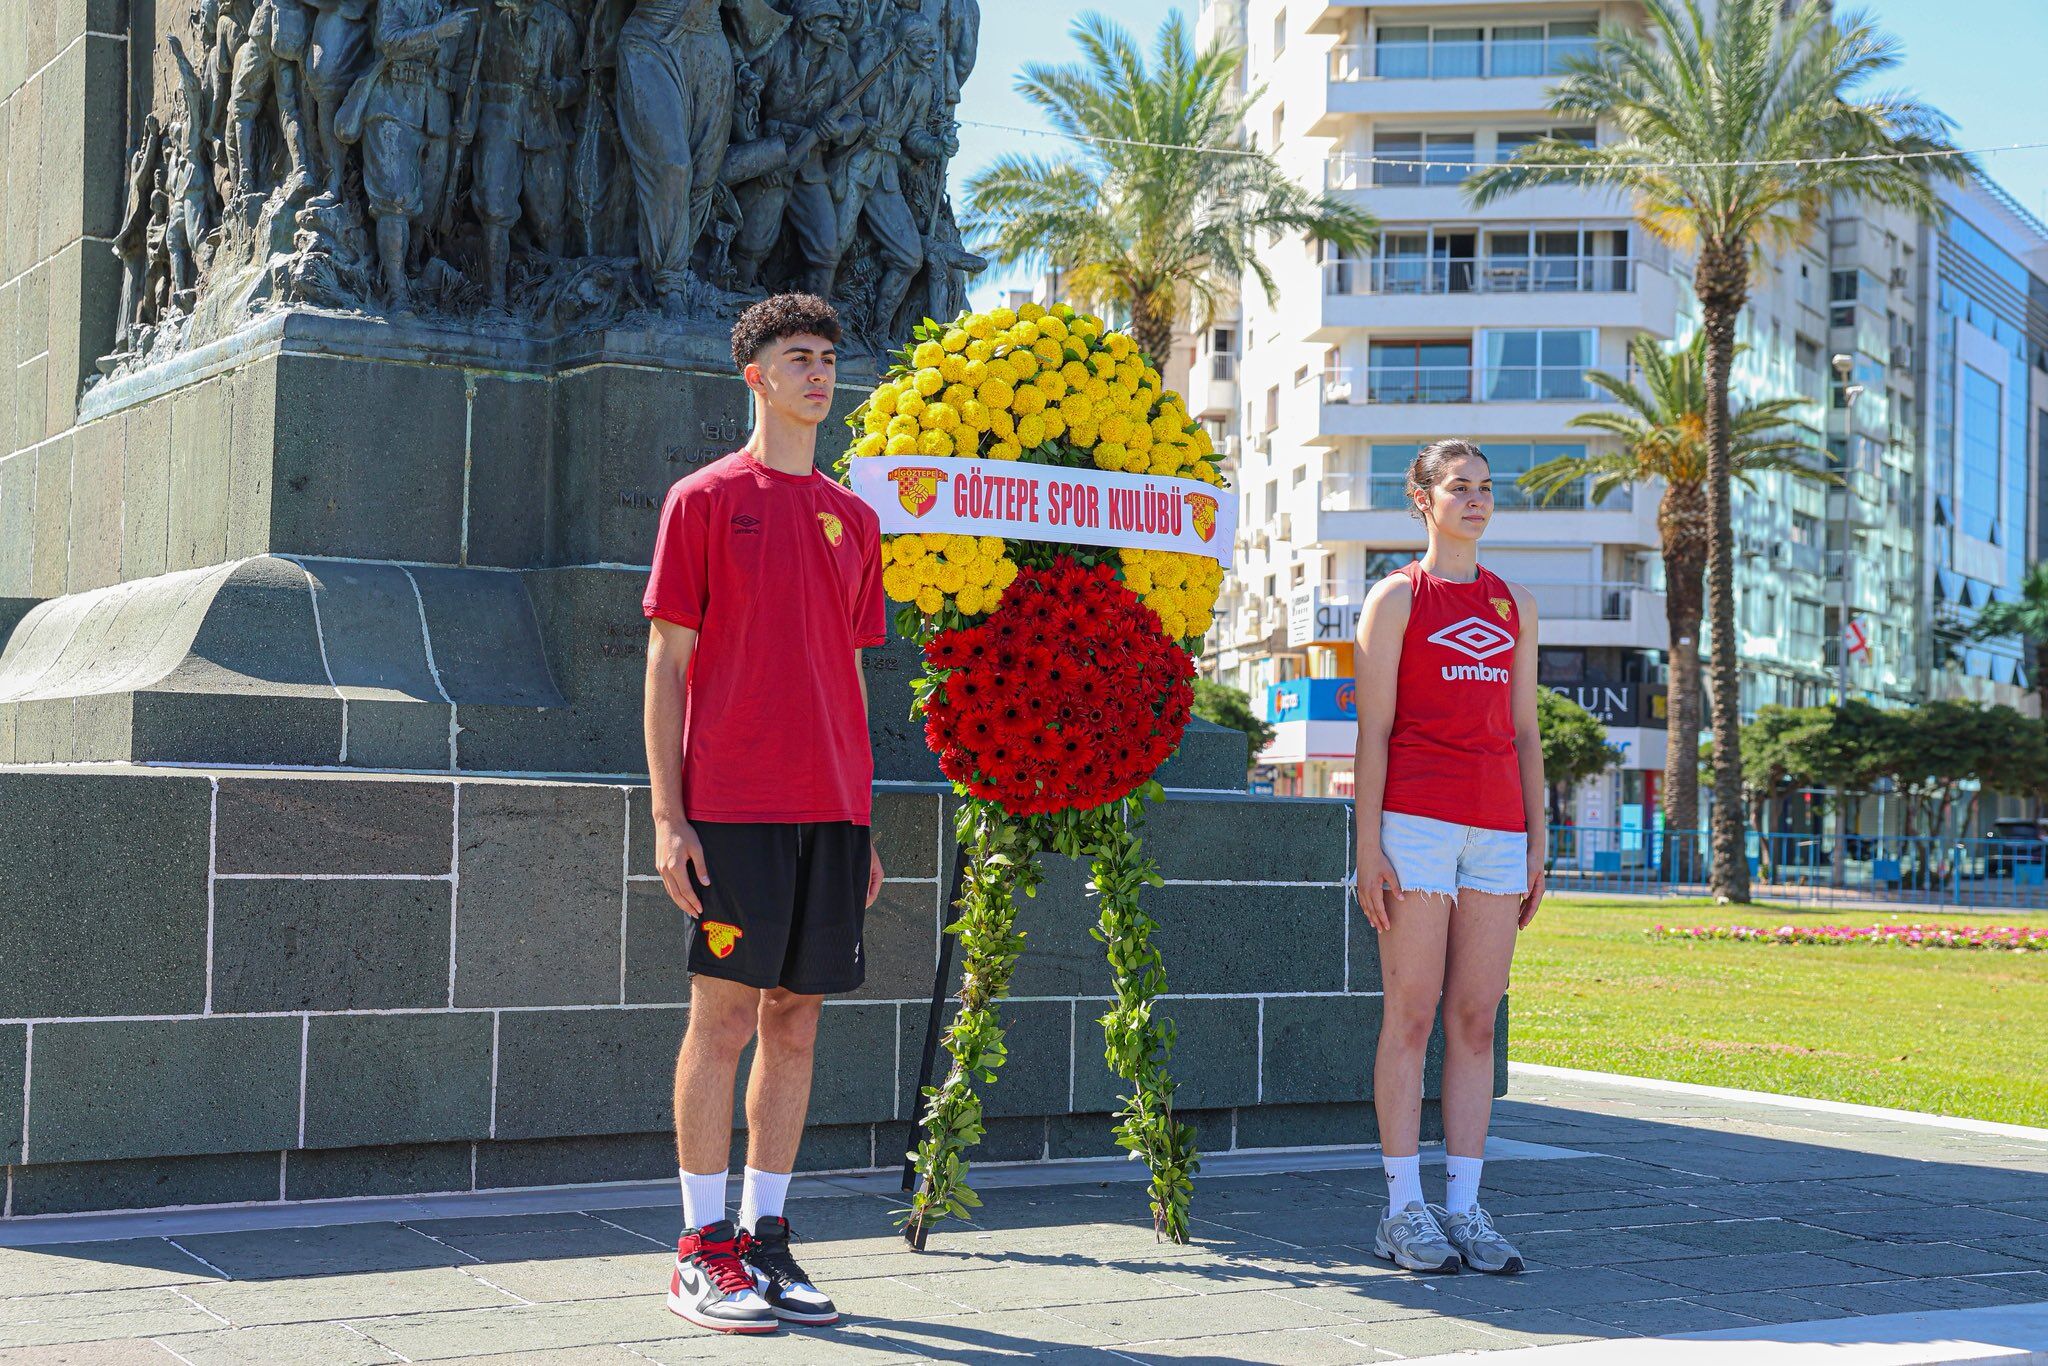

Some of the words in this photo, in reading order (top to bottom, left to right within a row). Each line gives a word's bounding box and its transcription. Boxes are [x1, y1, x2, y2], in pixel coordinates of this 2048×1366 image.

[954, 467, 1039, 523] GÖZTEPE
[1048, 480, 1100, 528] SPOR
[1108, 483, 1182, 537] KULÜBÜ
[1441, 661, 1509, 684] umbro
